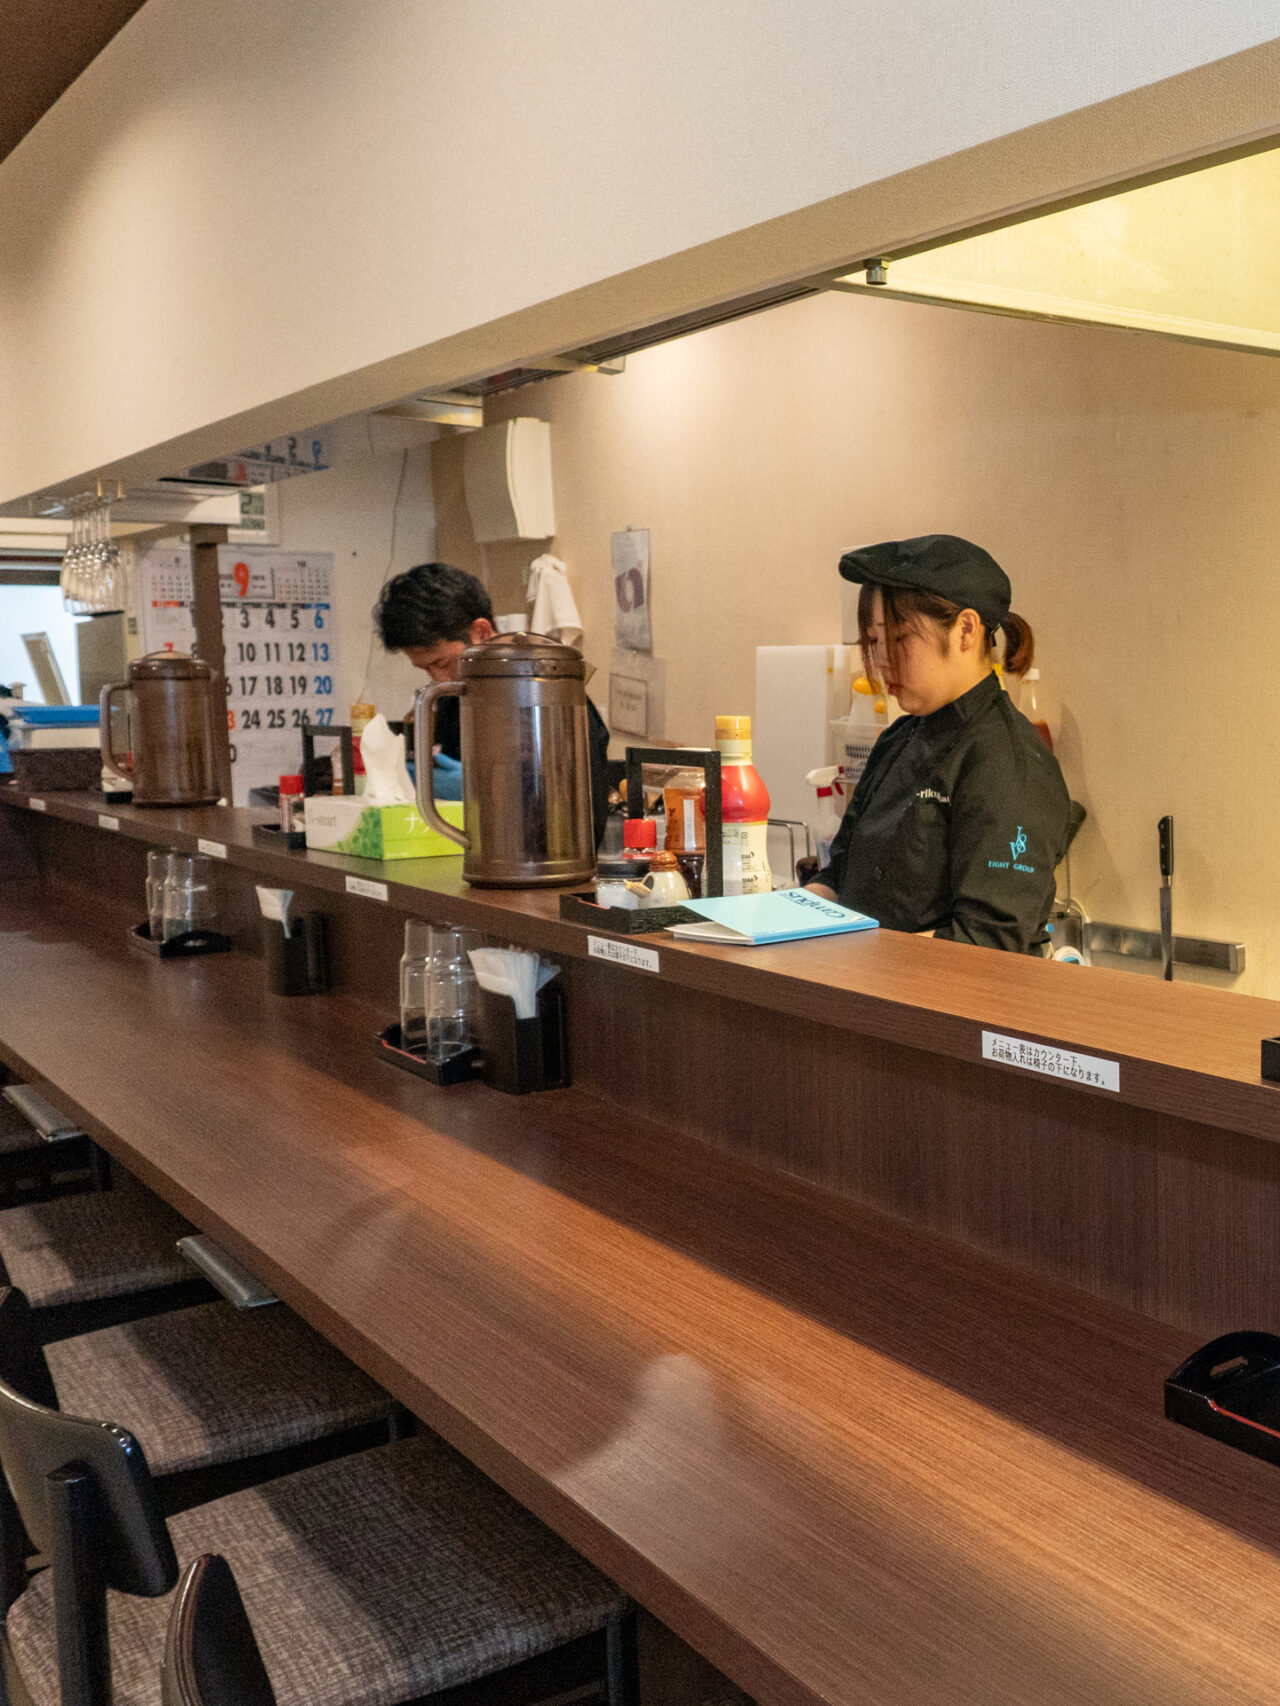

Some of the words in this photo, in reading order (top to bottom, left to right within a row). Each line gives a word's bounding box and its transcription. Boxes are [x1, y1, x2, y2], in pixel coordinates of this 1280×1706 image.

[233, 562, 249, 597] 9
[240, 609, 250, 628] 3
[265, 609, 275, 628] 4
[290, 609, 299, 628] 5
[314, 609, 324, 629] 6
[237, 642, 256, 662] 10
[263, 642, 281, 661] 11
[288, 642, 306, 662] 12
[312, 642, 330, 661] 13
[239, 676, 257, 696] 17
[265, 676, 283, 695] 18
[290, 676, 307, 695] 19
[314, 676, 332, 695] 20
[241, 709, 260, 729] 24
[267, 709, 286, 729] 25
[291, 709, 310, 728] 26
[315, 708, 333, 726] 27
[988, 860, 1010, 869] EIGHT
[1013, 863, 1035, 874] GROUP
[991, 1038, 1082, 1069] メニュー表はカウンター下、
